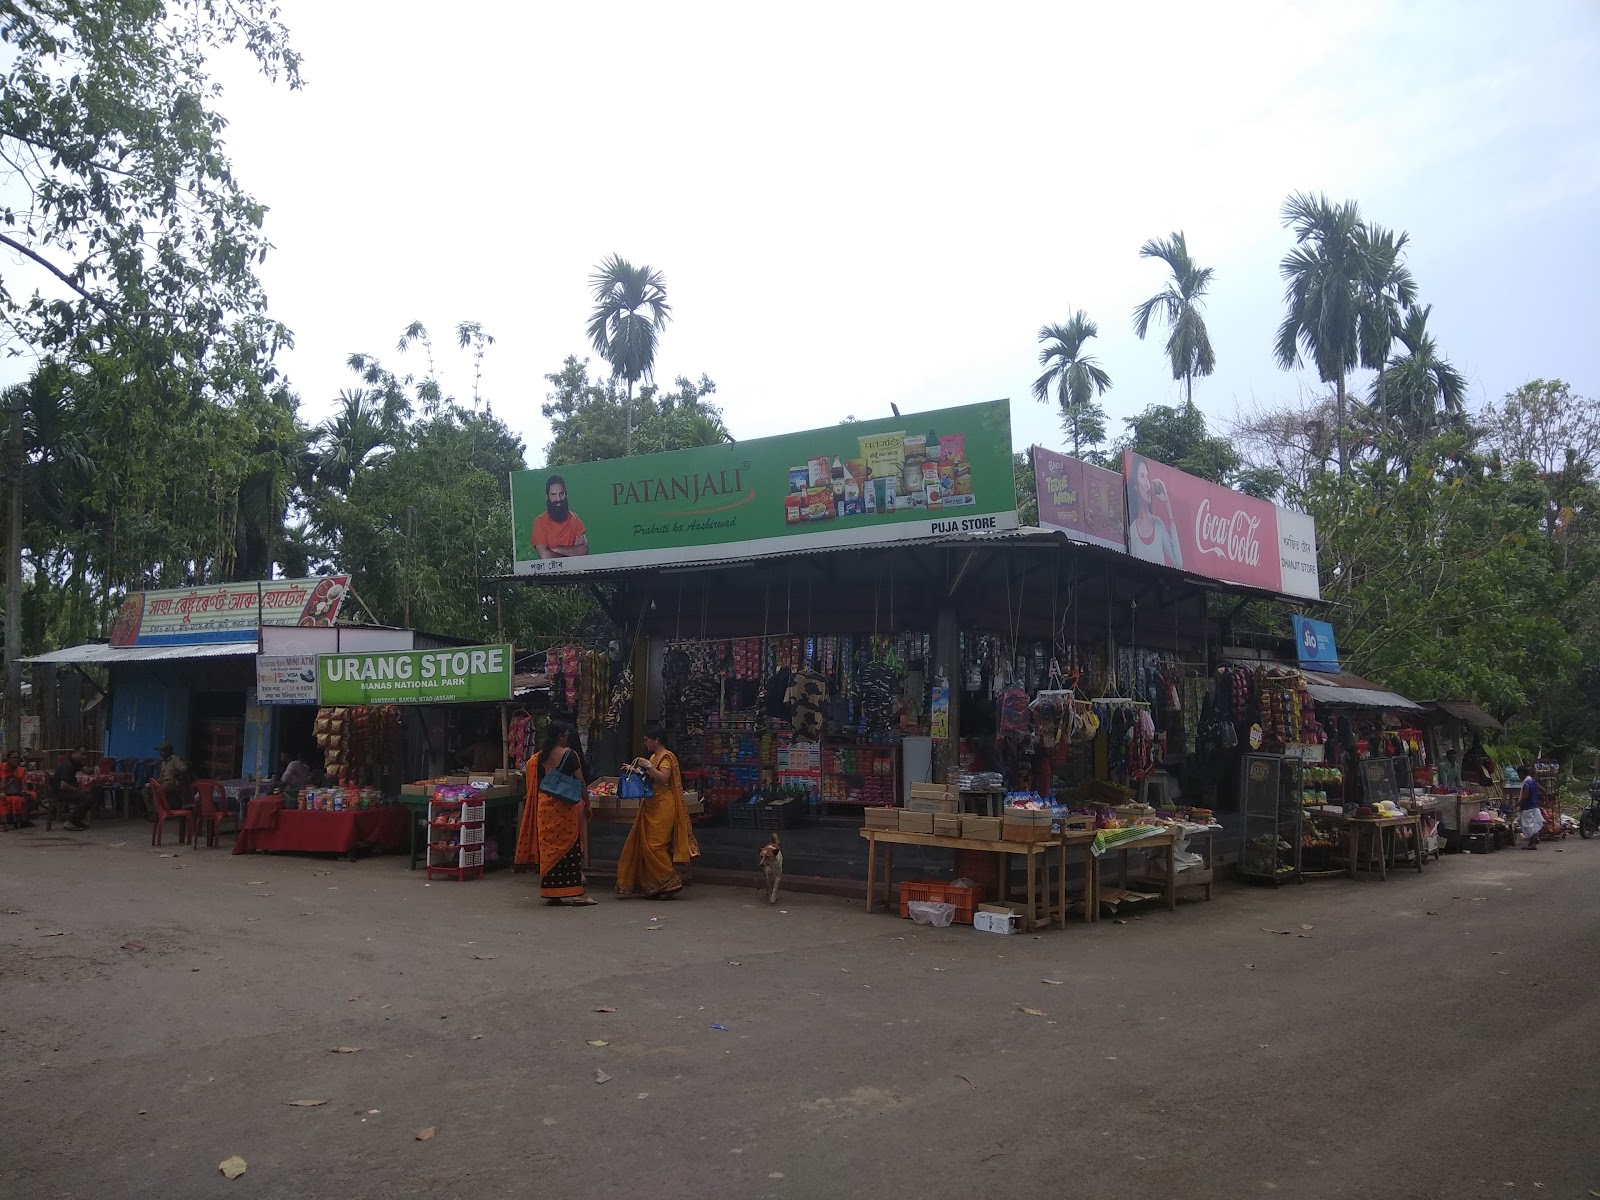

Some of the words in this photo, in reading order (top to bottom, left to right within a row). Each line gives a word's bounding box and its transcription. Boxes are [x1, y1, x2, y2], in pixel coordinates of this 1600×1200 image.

[611, 468, 744, 505] PATANJALI
[633, 523, 671, 537] Prakriti
[672, 520, 684, 533] ka
[687, 516, 737, 531] Aashirwad
[931, 519, 959, 534] PUJA
[962, 516, 997, 532] STORE
[1195, 499, 1260, 567] Coca-Cola
[1281, 557, 1301, 570] DHANJIT
[1301, 562, 1316, 575] STORE
[261, 583, 308, 609] হোটেল
[1303, 629, 1317, 649] Jio
[285, 658, 300, 667] MINI
[300, 656, 315, 666] ATM
[326, 656, 413, 682] URANG
[420, 649, 503, 678] STORE
[361, 681, 392, 690] MANAS
[394, 679, 439, 689] NATIONAL
[441, 677, 466, 686] PARK
[434, 694, 456, 702] (ASSAM)
